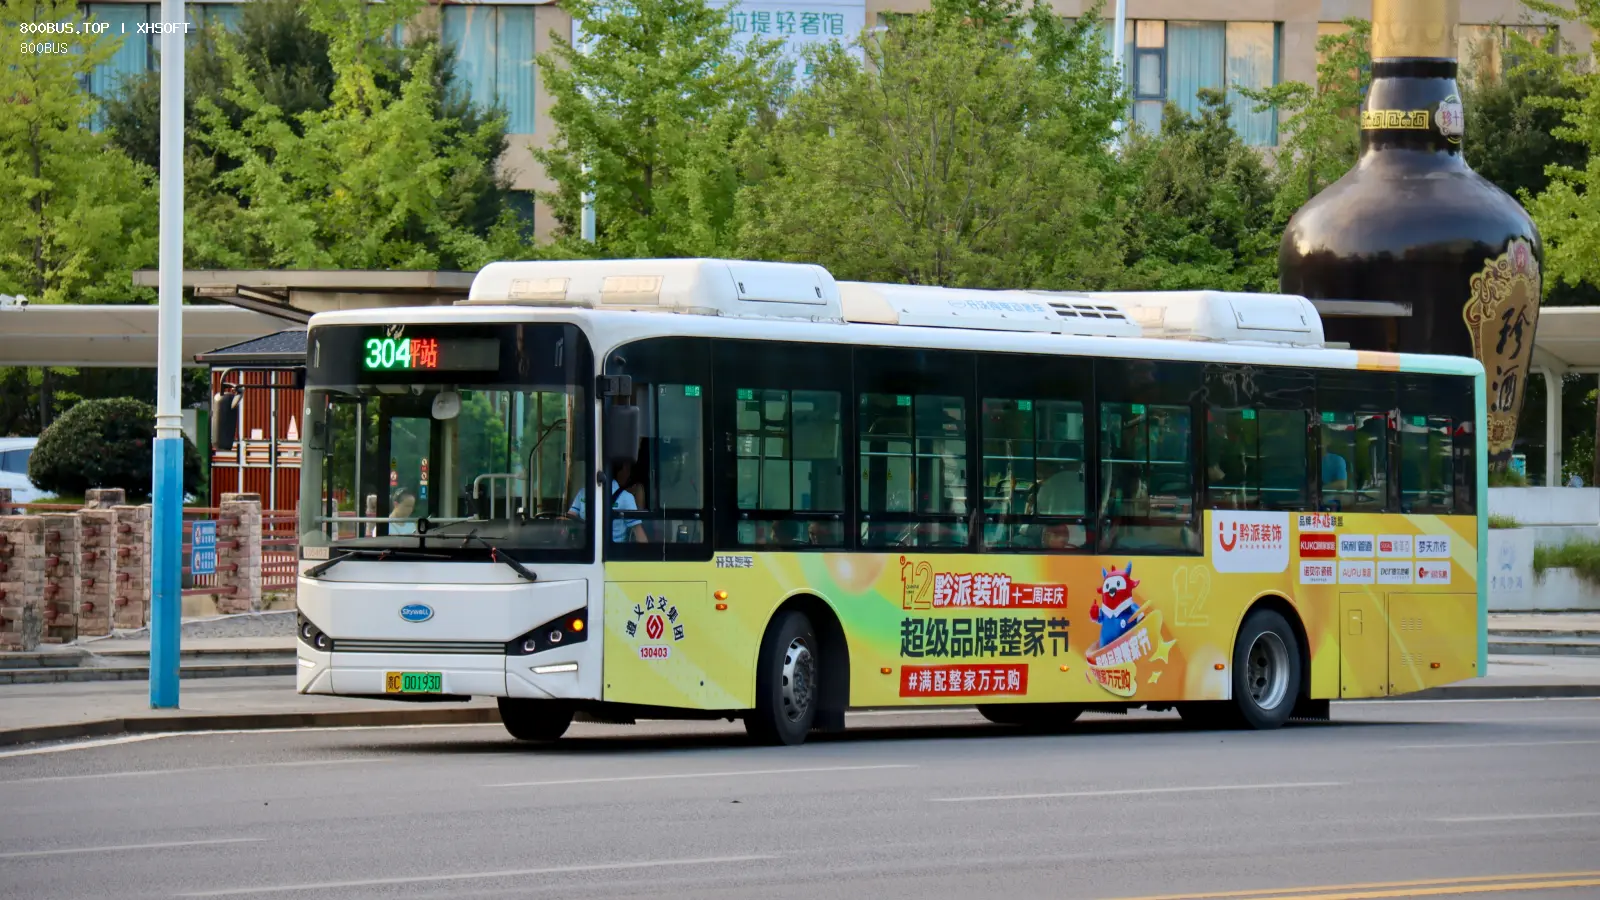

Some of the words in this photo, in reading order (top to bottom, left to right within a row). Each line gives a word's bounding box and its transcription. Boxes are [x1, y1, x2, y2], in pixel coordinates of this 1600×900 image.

[728, 11, 844, 35] 拉提轻奢馆
[365, 338, 411, 368] 304
[1239, 523, 1282, 543] 黔派装饰
[1418, 540, 1447, 553] 梦天木作
[933, 572, 1012, 608] 黔派装饰
[1011, 586, 1064, 605] 十二周年庆
[900, 616, 1070, 658] 超级品牌整家节
[640, 647, 668, 658] 130403
[908, 669, 1020, 692] #满配整家万元购
